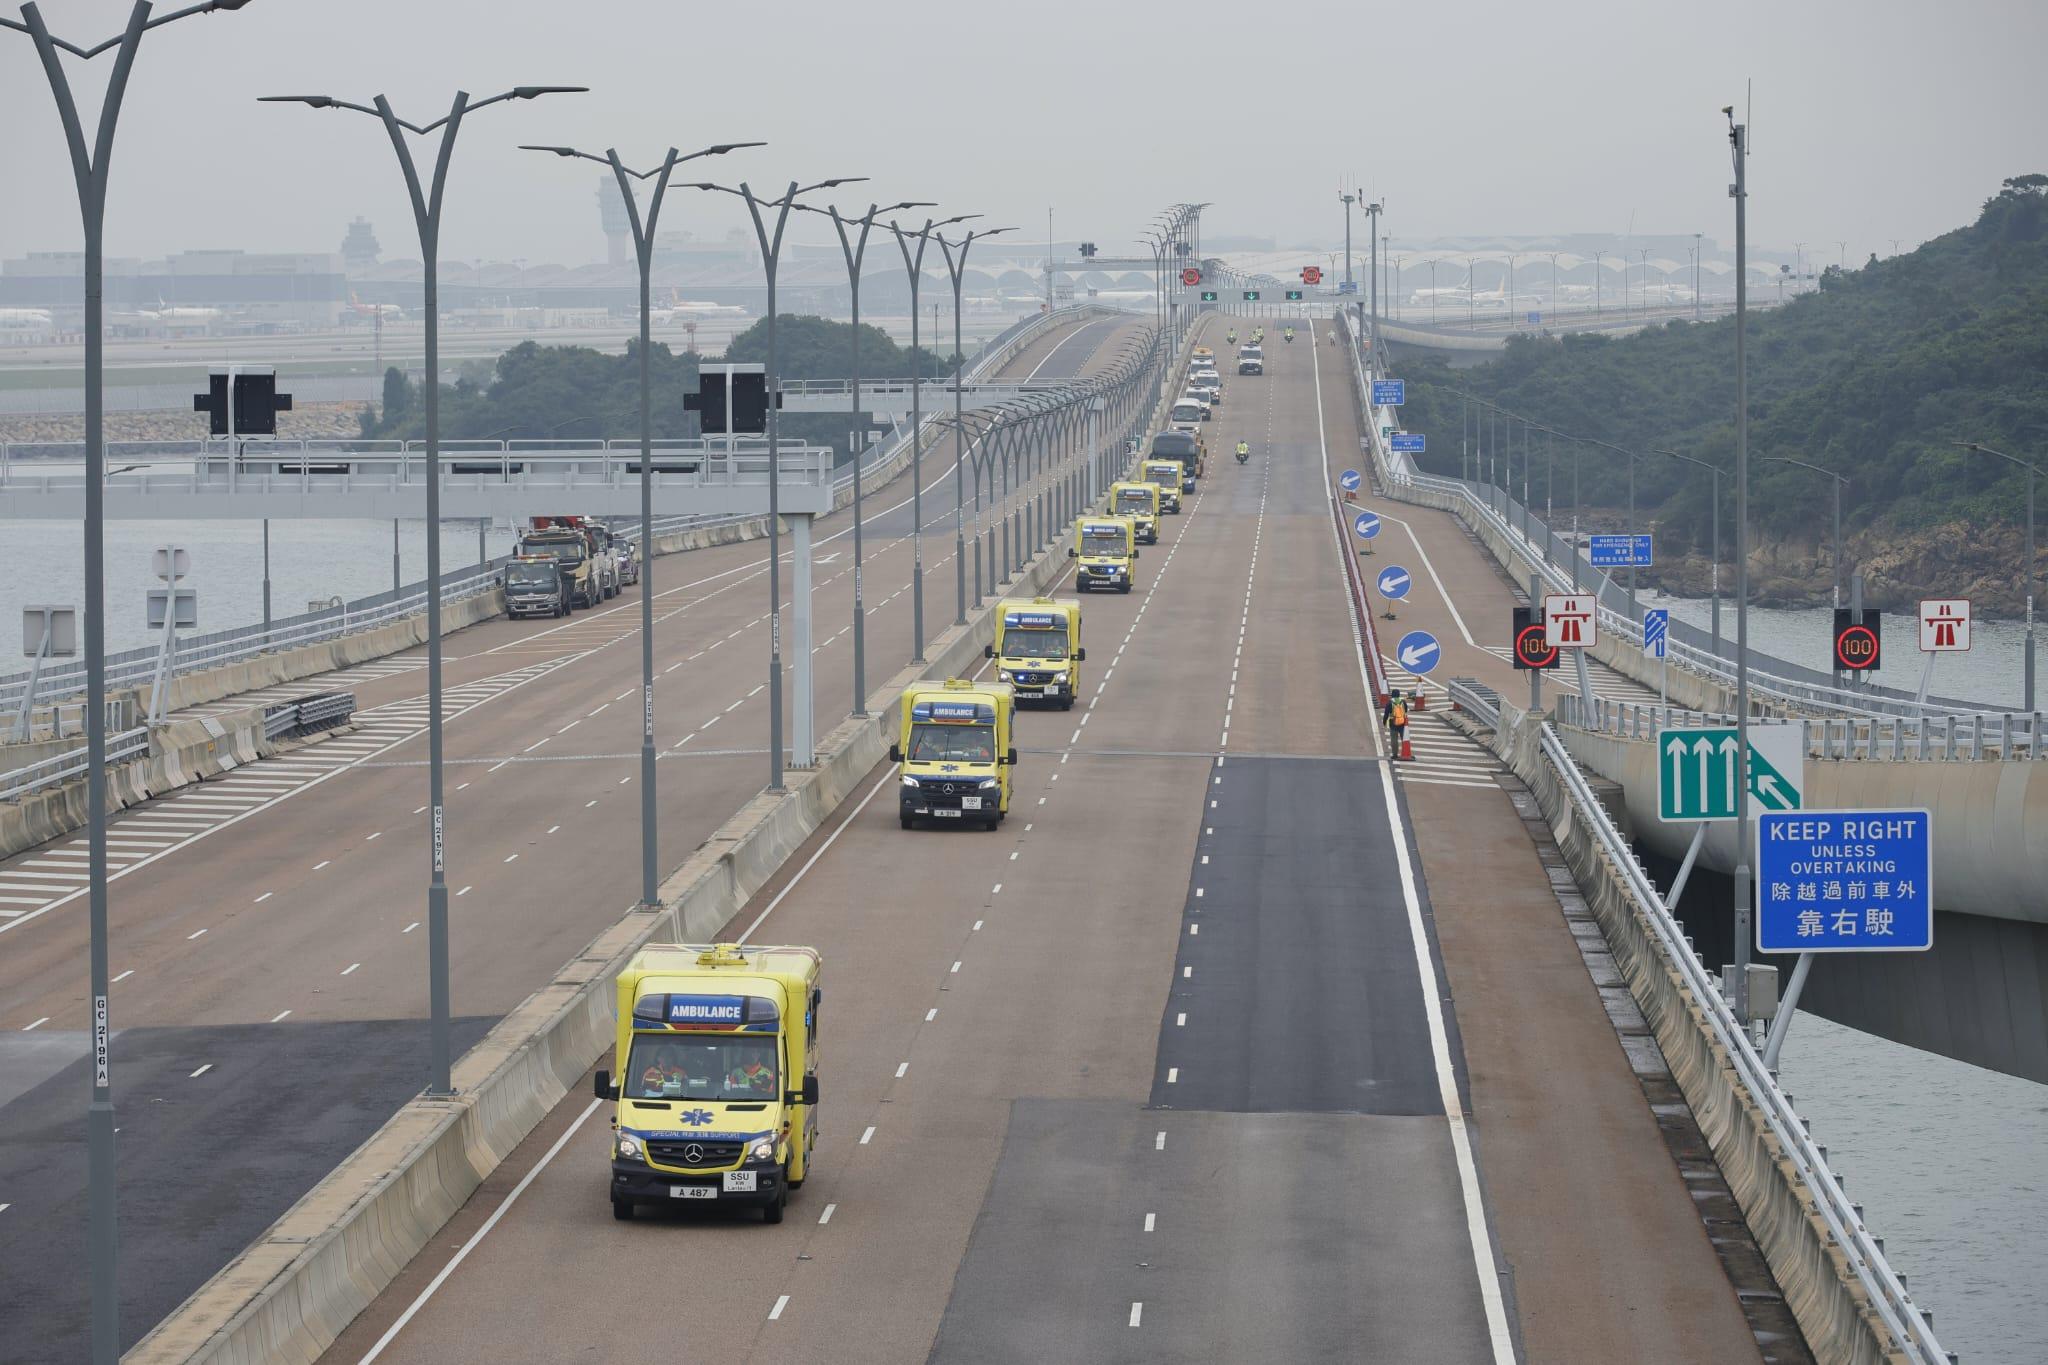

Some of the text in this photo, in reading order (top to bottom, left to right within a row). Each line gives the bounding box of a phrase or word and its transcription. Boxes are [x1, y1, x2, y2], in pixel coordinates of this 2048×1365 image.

[1844, 639, 1872, 655] 100
[934, 708, 975, 716] AMBULANCE
[436, 808, 442, 824] GC
[1771, 821, 1916, 840] KEEP RIGHT
[1811, 844, 1876, 858] UNLESS
[1790, 860, 1896, 875] OVERTAKING
[1771, 880, 1917, 901] 除越過前車外
[1797, 908, 1894, 937] 靠右駛
[671, 1005, 741, 1018] AMBULANCE
[97, 999, 106, 1080] GC 2196 A
[730, 1172, 750, 1181] SSU
[679, 1188, 709, 1198] A 487
